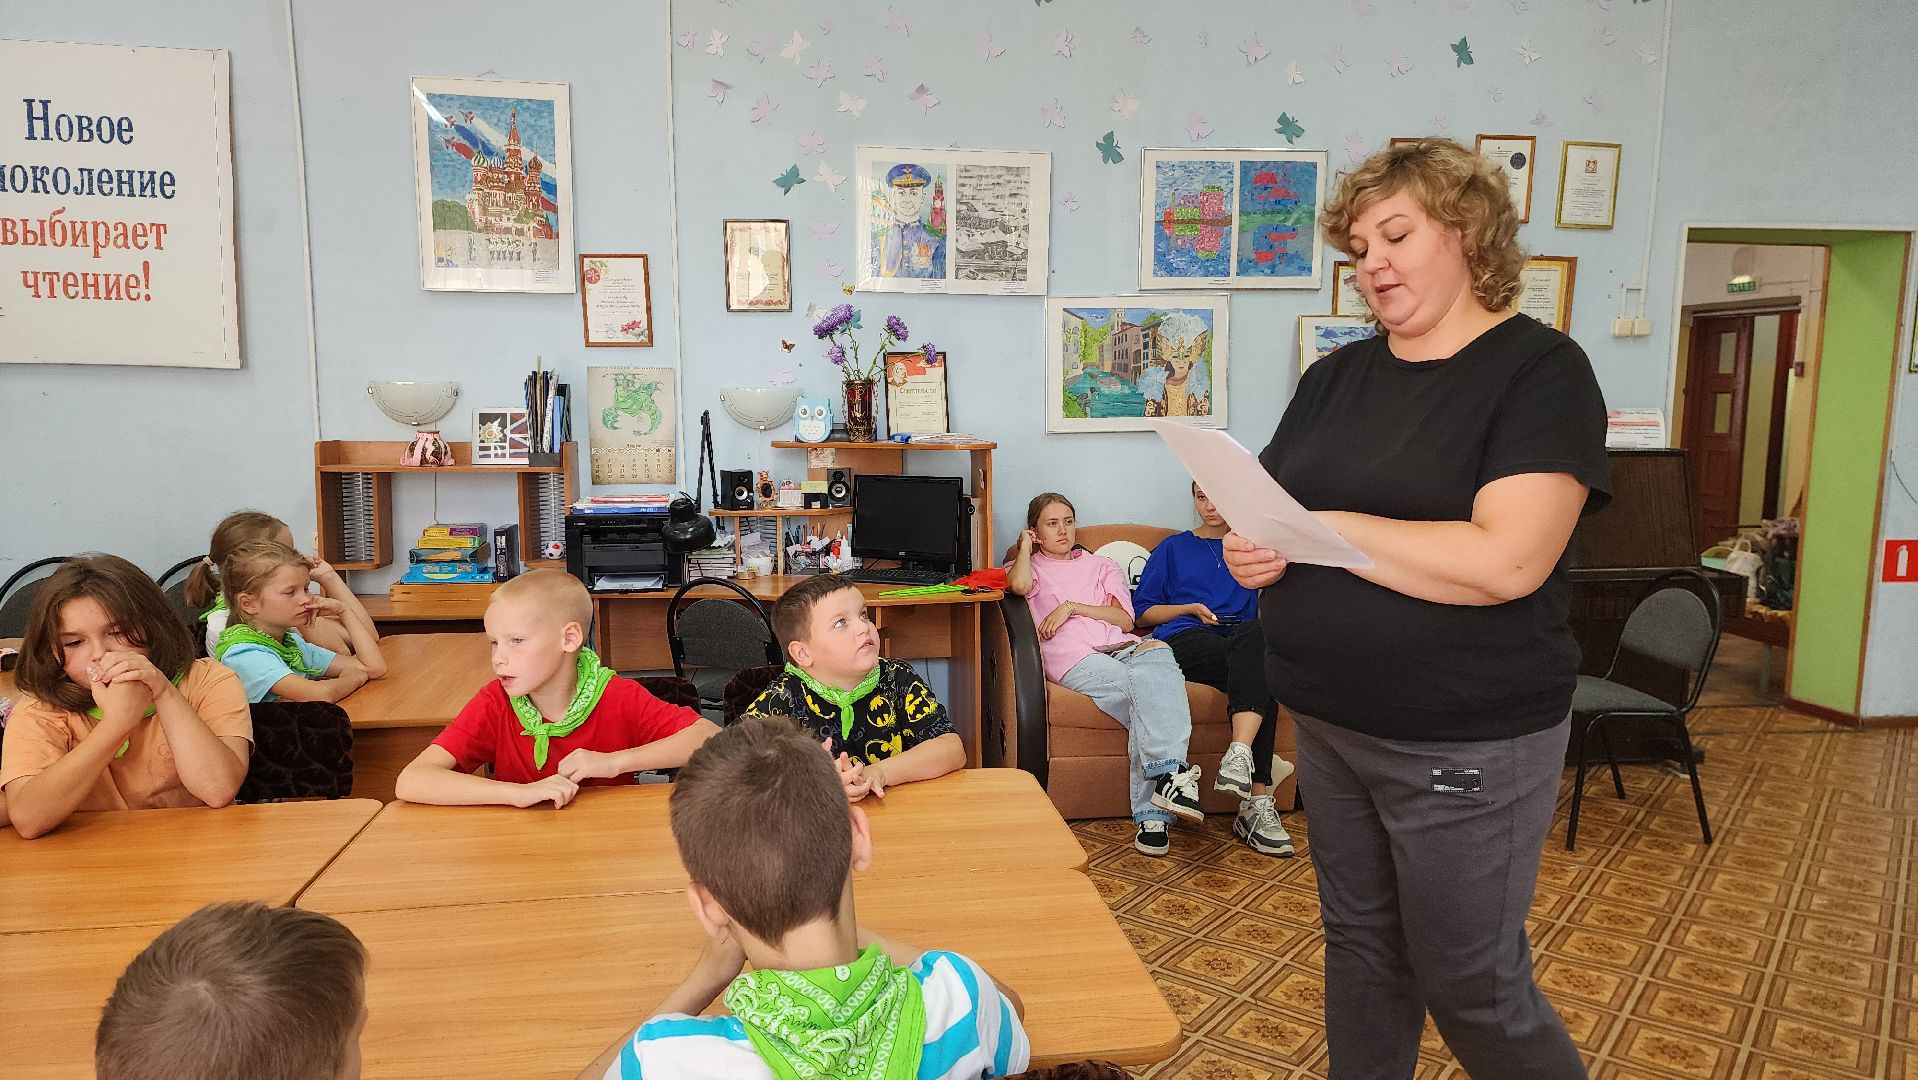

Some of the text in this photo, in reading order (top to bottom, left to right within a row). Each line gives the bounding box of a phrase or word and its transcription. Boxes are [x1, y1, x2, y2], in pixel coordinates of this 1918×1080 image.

[23, 99, 134, 145] Новое
[0, 206, 168, 258] выбирает
[20, 261, 152, 302] чтение!
